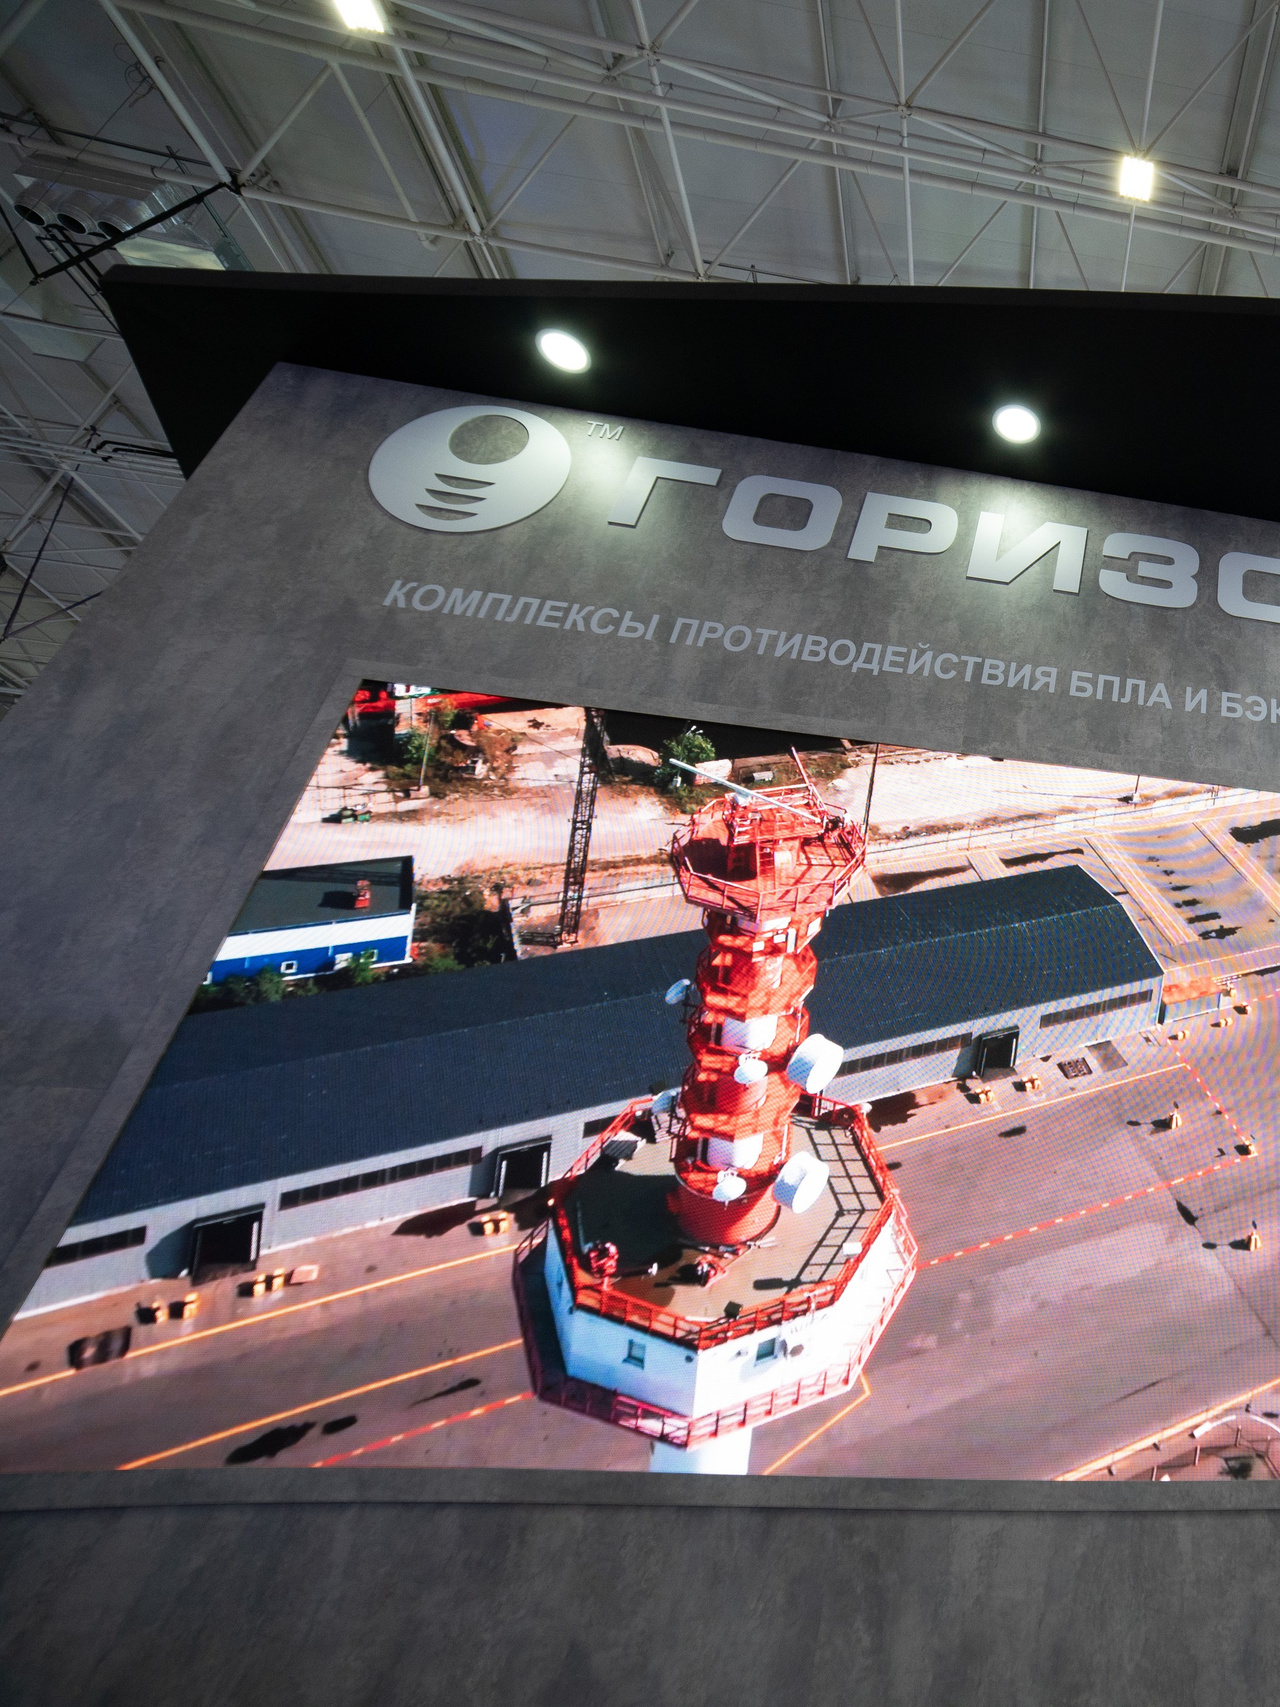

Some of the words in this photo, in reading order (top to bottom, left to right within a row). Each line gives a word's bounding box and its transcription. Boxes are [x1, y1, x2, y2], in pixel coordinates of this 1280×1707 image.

[383, 579, 659, 641] КОМПЛЕКСЫ
[669, 617, 1056, 694] ПРОТИВОДЕЙСТВИЯ
[1069, 672, 1171, 710] БПЛА
[1185, 688, 1208, 714] И
